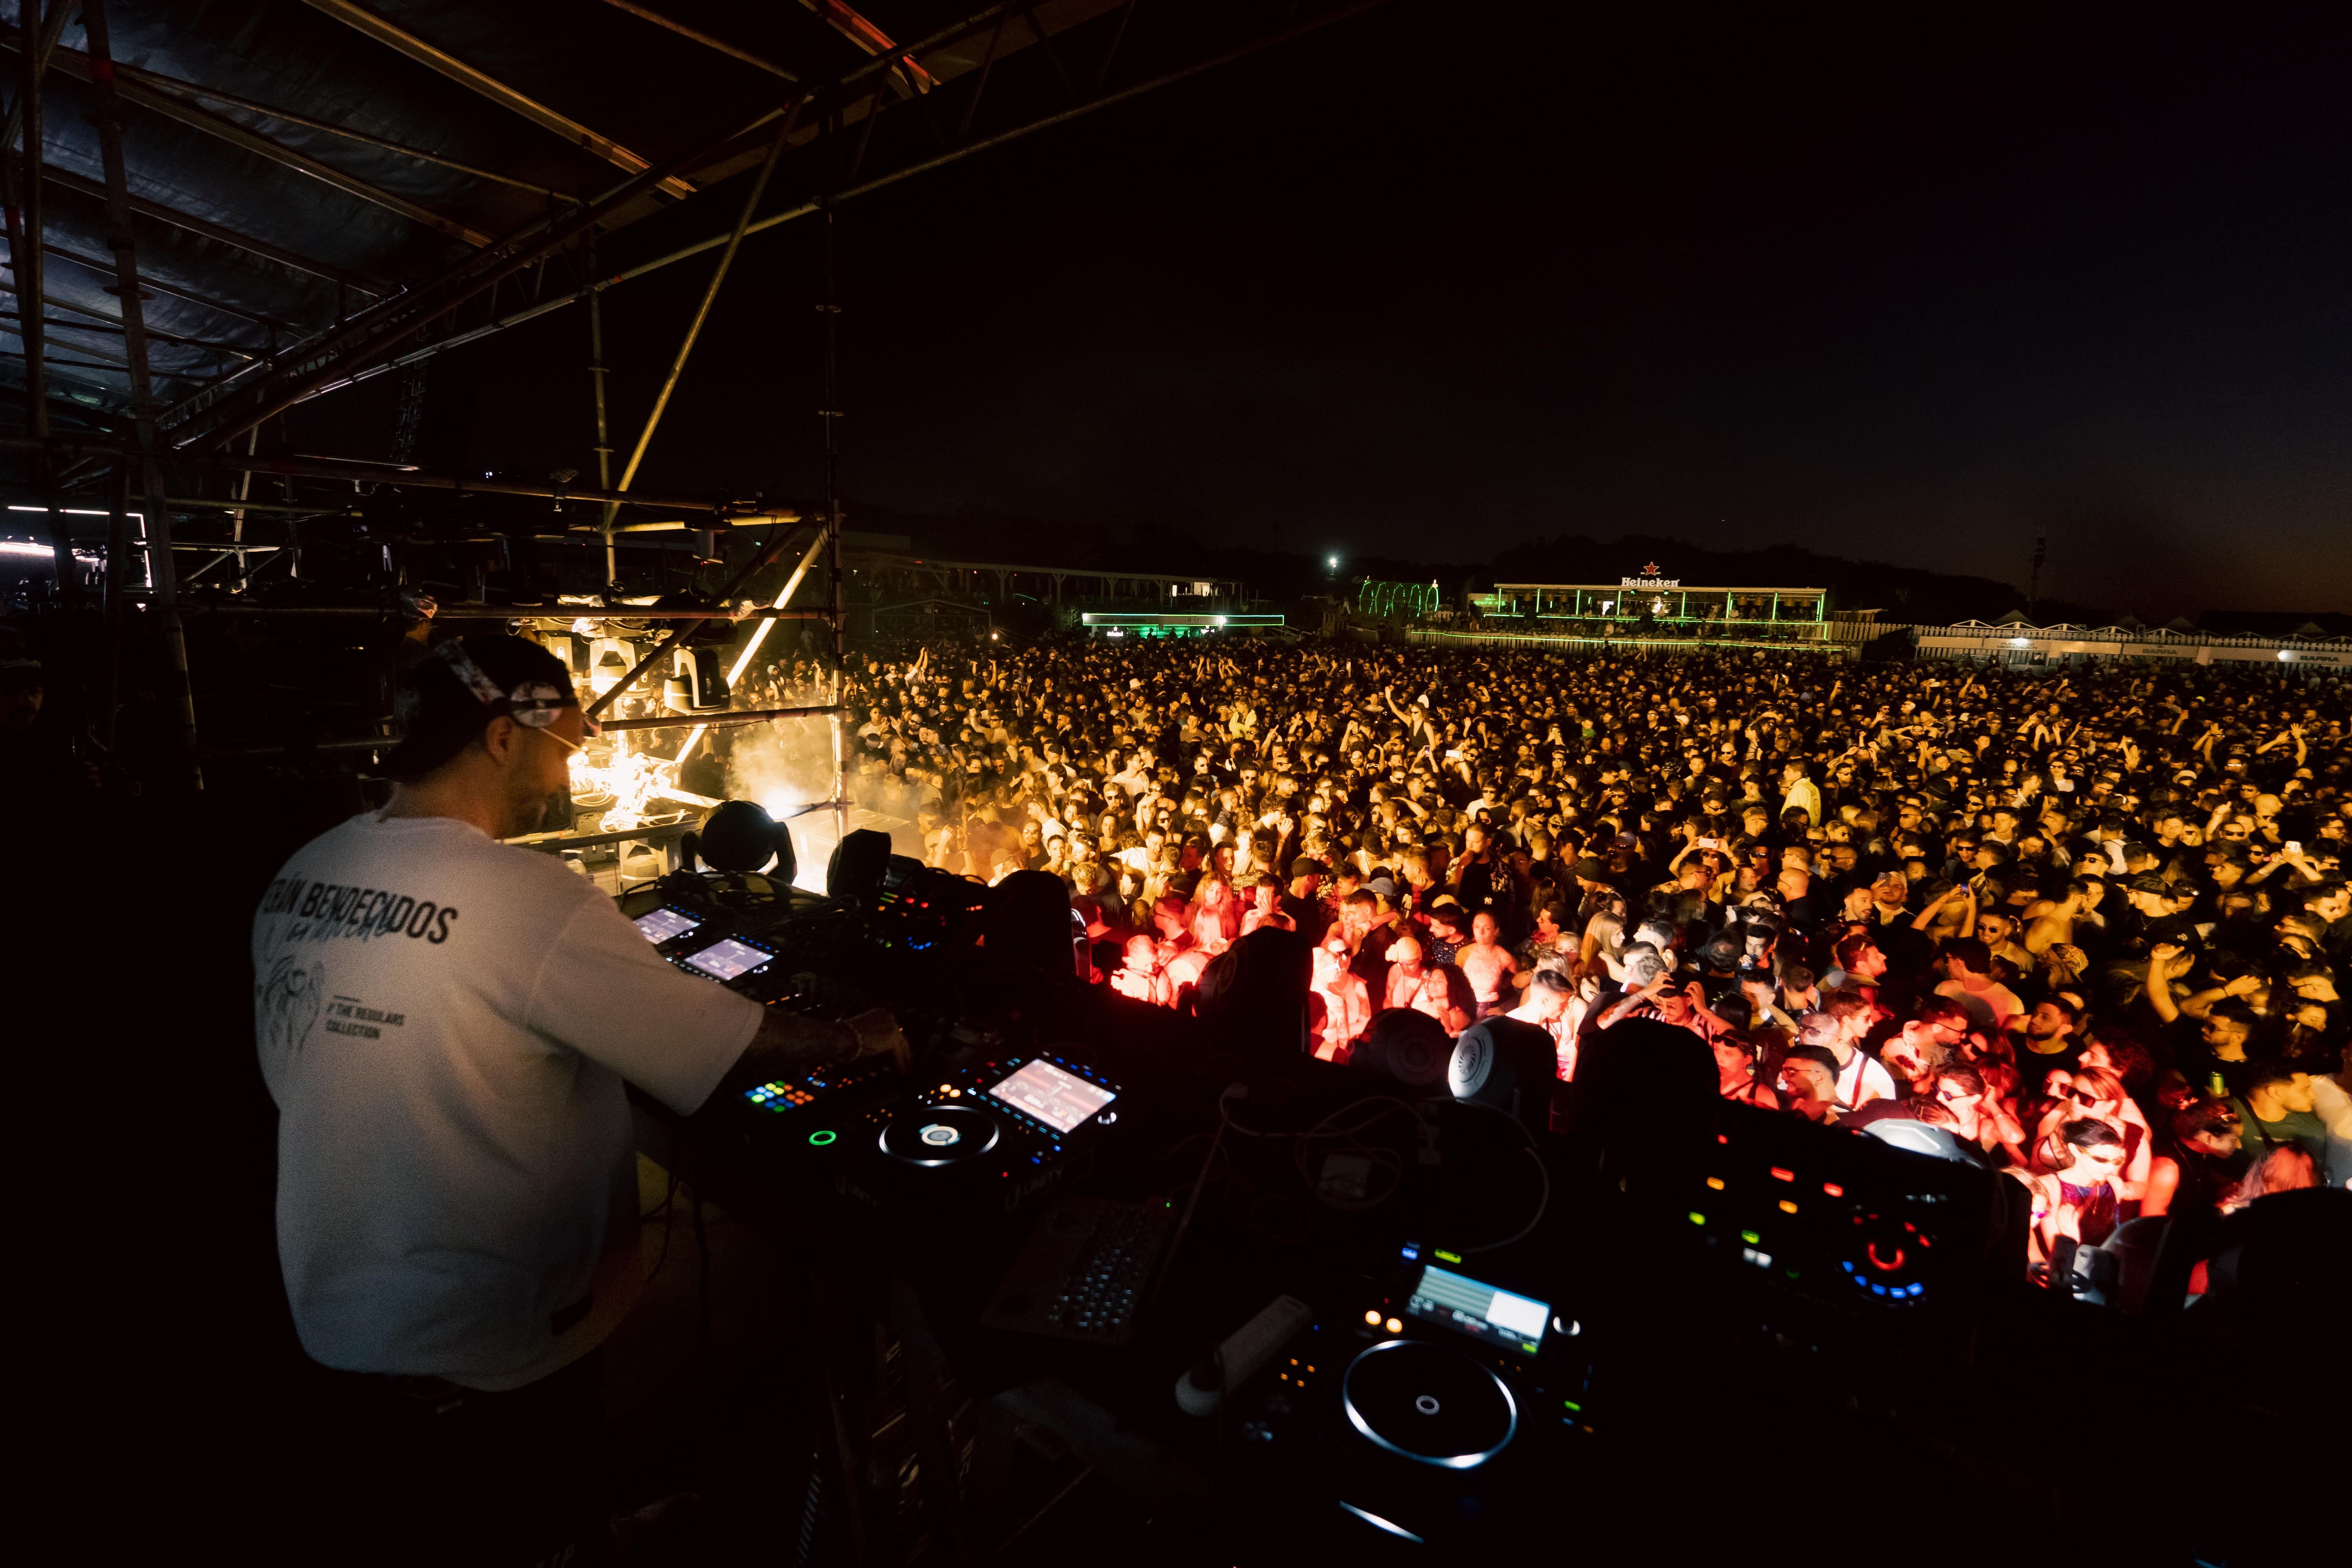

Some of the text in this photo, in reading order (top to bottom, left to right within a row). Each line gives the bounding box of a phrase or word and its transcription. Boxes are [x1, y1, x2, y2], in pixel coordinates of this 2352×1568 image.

[1621, 577, 1679, 588] Heineken
[1484, 897, 1493, 905] NY
[299, 882, 458, 944] BENDECIDOS
